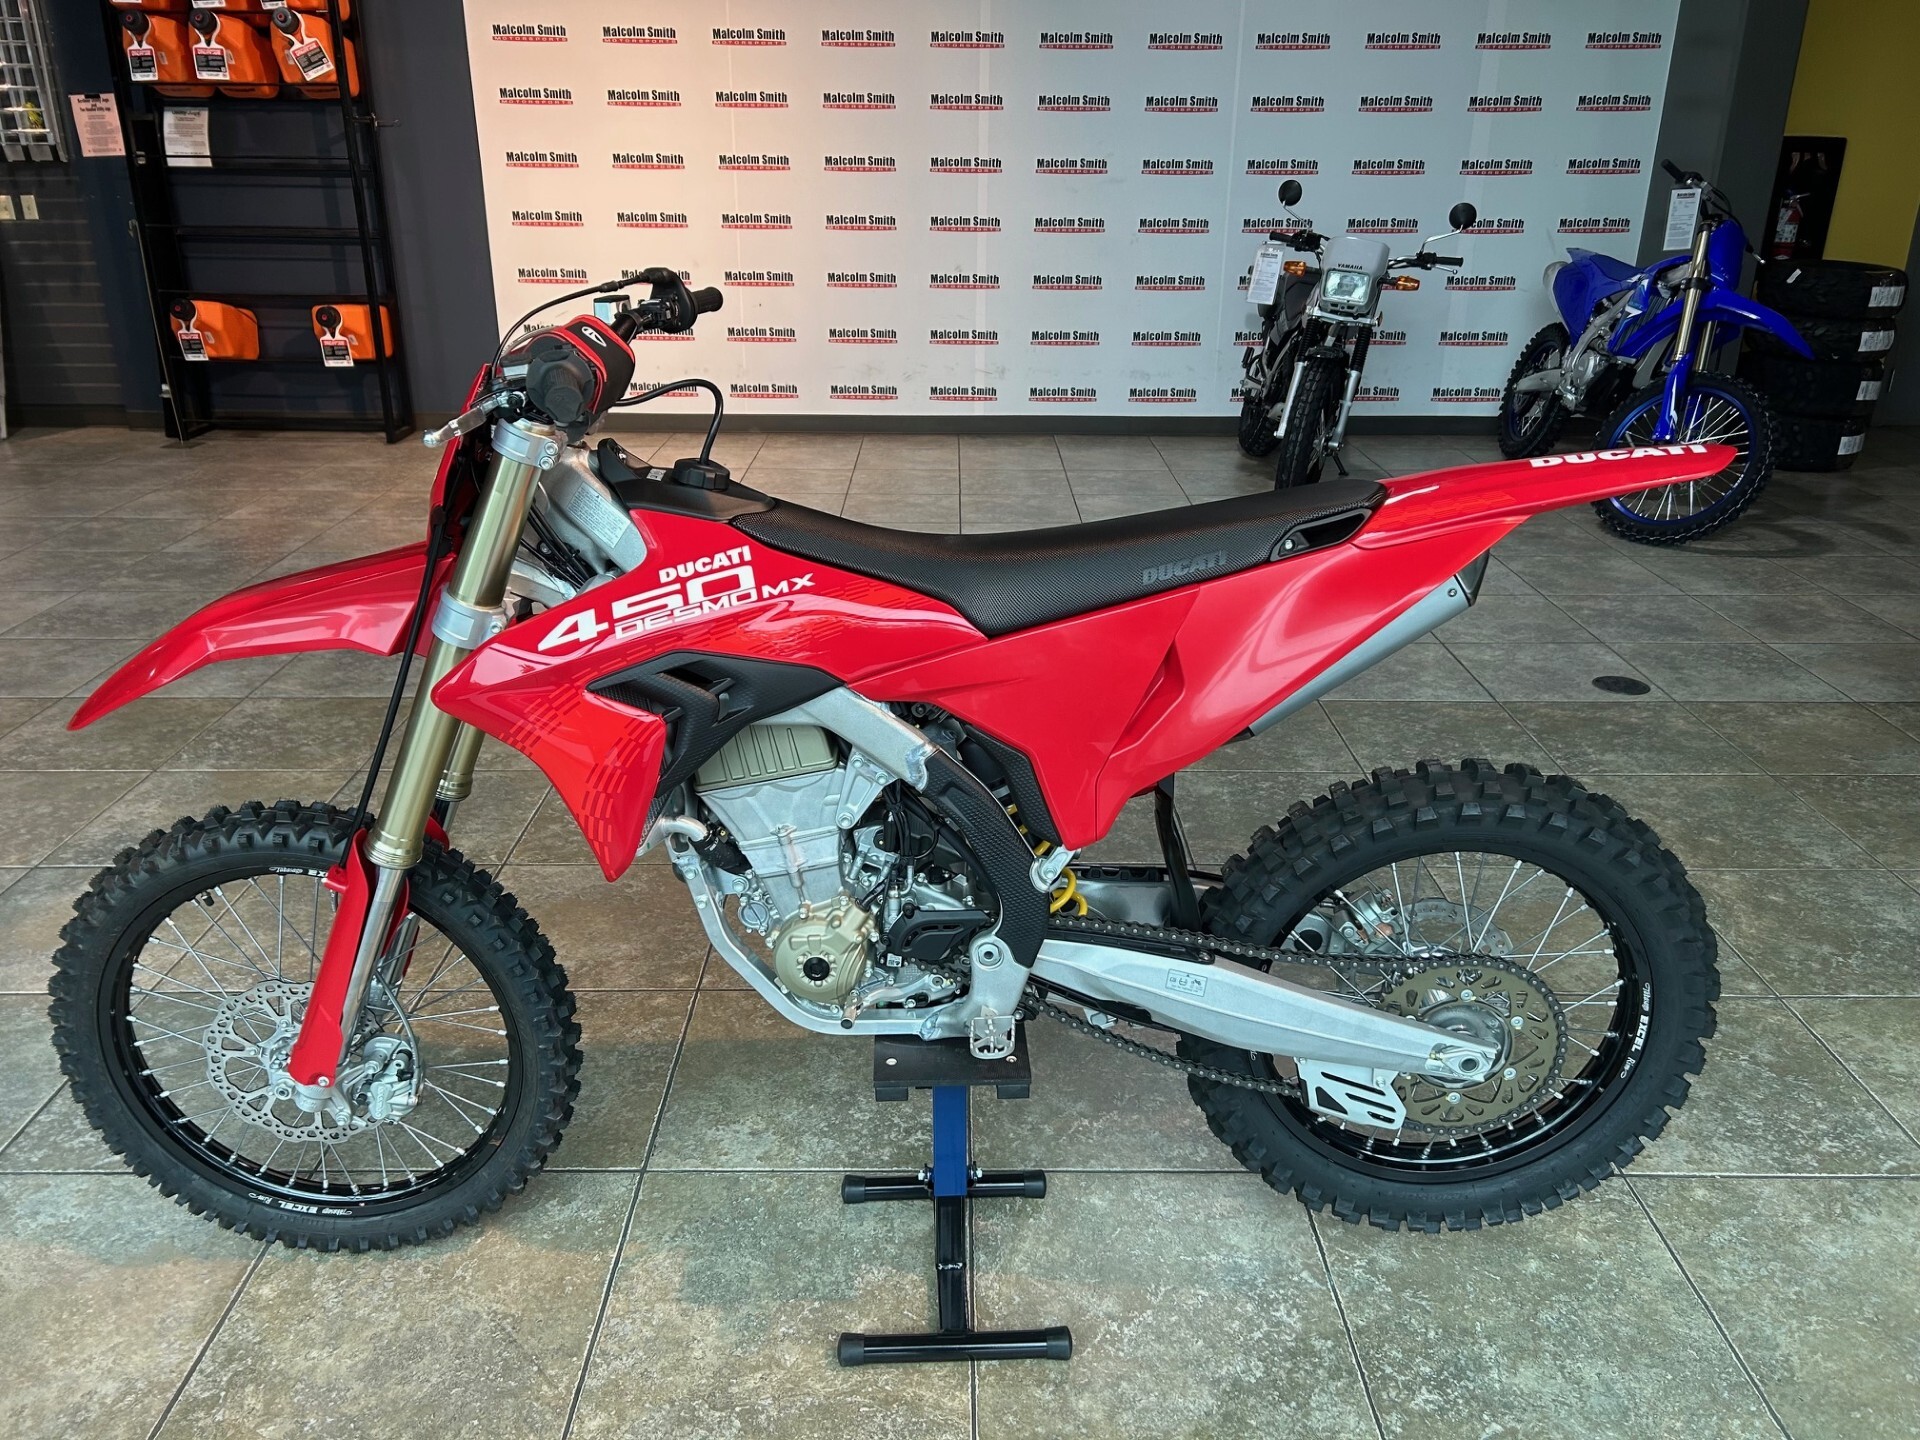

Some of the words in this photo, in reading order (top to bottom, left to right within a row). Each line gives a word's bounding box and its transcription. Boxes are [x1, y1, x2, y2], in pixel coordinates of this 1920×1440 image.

[492, 23, 536, 35] Malcolm
[537, 24, 567, 37] Smith
[602, 25, 646, 38] Malcolm
[647, 26, 676, 39] Smith
[712, 27, 755, 40] Malcolm
[756, 28, 786, 41] Smith
[821, 29, 864, 41] Malcolm
[865, 29, 895, 42] Smith
[930, 30, 973, 43] Malcolm
[975, 30, 1005, 44] Smith
[1040, 31, 1083, 44] Malcolm
[1084, 32, 1113, 44] Smith
[1149, 32, 1192, 45] Malcolm
[1193, 32, 1223, 45] Smith
[1257, 32, 1300, 45] Malcolm
[1301, 32, 1331, 45] Smith
[1366, 32, 1410, 44] Malcolm
[1411, 32, 1441, 44] Smith
[1477, 32, 1521, 44] Malcolm
[1522, 32, 1552, 44] Smith
[1587, 31, 1631, 44] Malcolm
[1632, 31, 1662, 44] Smith
[499, 87, 542, 99] Malcolm
[543, 87, 572, 100] Smith
[607, 89, 650, 101] Malcolm
[651, 89, 680, 102] Smith
[715, 90, 757, 102] Malcolm
[759, 91, 788, 103] Smith
[823, 92, 865, 104] Malcolm
[866, 92, 895, 105] Smith
[930, 93, 973, 105] Malcolm
[974, 93, 1003, 106] Smith
[1038, 94, 1080, 106] Malcolm
[1082, 94, 1110, 107] Smith
[1146, 95, 1188, 107] Malcolm
[1189, 95, 1218, 107] Smith
[1252, 95, 1294, 107] Malcolm
[1295, 95, 1325, 107] Smith
[1360, 95, 1403, 107] Malcolm
[1404, 95, 1433, 107] Smith
[1469, 95, 1512, 107] Malcolm
[1513, 94, 1543, 107] Smith
[1578, 94, 1621, 107] Malcolm
[1622, 94, 1651, 106] Smith
[505, 151, 548, 162] Malcolm
[549, 151, 578, 163] Smith
[612, 152, 654, 164] Malcolm
[655, 153, 684, 165] Smith
[718, 154, 760, 165] Malcolm
[761, 154, 790, 166] Smith
[824, 155, 866, 166] Malcolm
[867, 155, 896, 167] Smith
[930, 156, 972, 168] Malcolm
[973, 156, 1002, 169] Smith
[1036, 157, 1078, 169] Malcolm
[1079, 158, 1108, 169] Smith
[1142, 158, 1184, 169] Malcolm
[1185, 158, 1214, 170] Smith
[1247, 158, 1289, 170] Malcolm
[1290, 158, 1319, 170] Smith
[1353, 159, 1395, 170] Malcolm
[1396, 158, 1425, 170] Smith
[1461, 159, 1503, 170] Malcolm
[1504, 158, 1533, 170] Smith
[1568, 158, 1611, 170] Malcolm
[1611, 157, 1641, 169] Smith
[511, 210, 553, 221] Malcolm
[554, 210, 583, 222] Smith
[616, 211, 658, 223] Malcolm
[659, 212, 687, 224] Smith
[721, 213, 762, 224] Malcolm
[764, 213, 792, 225] Smith
[826, 214, 867, 225] Malcolm
[868, 214, 896, 226] Smith
[930, 215, 971, 227] Malcolm
[972, 215, 1001, 228] Smith
[1035, 217, 1076, 228] Malcolm
[1077, 217, 1105, 228] Smith
[1139, 217, 1180, 229] Malcolm
[1181, 217, 1209, 229] Smith
[1243, 218, 1284, 229] Malcolm
[1347, 217, 1389, 229] Malcolm
[1390, 217, 1419, 229] Smith
[1471, 219, 1495, 229] colm
[1496, 218, 1525, 229] Smith
[1559, 217, 1601, 229] Malcolm
[1602, 217, 1631, 228] Smith
[517, 267, 558, 278] Malcolm
[559, 268, 587, 279] Smith
[1337, 263, 1364, 271] YAMAHA
[724, 270, 765, 281] Malcolm
[766, 270, 794, 282] Smith
[827, 271, 868, 283] Malcolm
[869, 272, 897, 284] Smith
[930, 273, 970, 284] Malcolm
[972, 273, 1000, 285] Smith
[1033, 274, 1073, 285] Malcolm
[1075, 274, 1102, 286] Smith
[1136, 275, 1176, 286] Malcolm
[1177, 275, 1205, 286] Smith
[1446, 275, 1487, 286] Malcolm
[1488, 275, 1516, 286] Smith
[727, 326, 767, 337] Malcolm
[768, 326, 796, 338] Smith
[829, 328, 869, 338] Malcolm
[870, 328, 897, 339] Smith
[930, 329, 970, 340] Malcolm
[971, 329, 998, 341] Smith
[1031, 330, 1071, 341] Malcolm
[1072, 330, 1100, 342] Smith
[1132, 331, 1172, 342] Malcolm
[1174, 331, 1201, 342] Smith
[1234, 331, 1263, 342] Malco
[1379, 330, 1407, 341] Smith
[1440, 331, 1480, 342] Malcolm
[1481, 331, 1508, 342] Smith
[730, 383, 770, 393] Malcolm
[771, 383, 798, 394] Smith
[830, 384, 869, 395] Malcolm
[871, 384, 898, 396] Smith
[930, 386, 969, 396] Malcolm
[970, 386, 997, 397] Smith
[1029, 387, 1069, 397] Malcolm
[1070, 387, 1097, 398] Smith
[1129, 387, 1168, 398] Malcolm
[1169, 387, 1197, 398] Smith
[1372, 386, 1400, 397] Smith
[1432, 387, 1472, 398] Malcolm
[1473, 386, 1501, 398] Smith
[1529, 444, 1708, 468] DUCATI
[659, 545, 753, 584] DUCATI
[1142, 550, 1228, 586] DUCATI
[538, 565, 756, 651] 450
[614, 587, 758, 640] DESMO
[761, 573, 816, 600] MX
[1631, 1014, 1650, 1052] EXCEL
[278, 1200, 319, 1215] EXCEL
